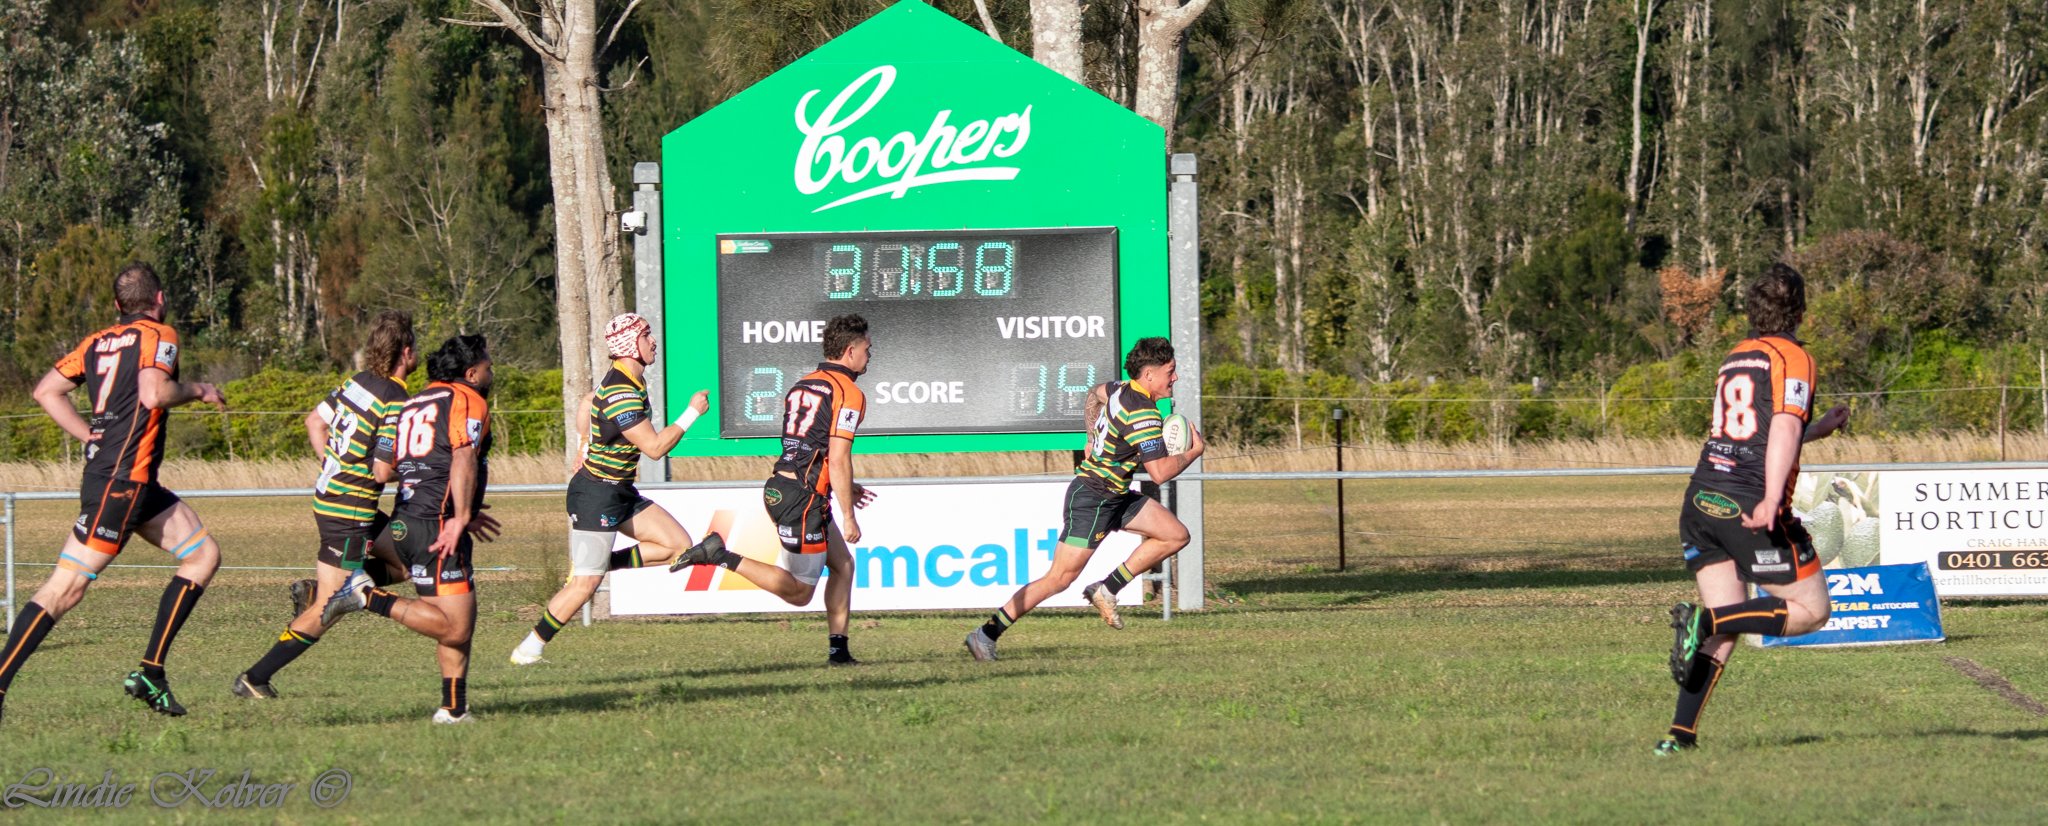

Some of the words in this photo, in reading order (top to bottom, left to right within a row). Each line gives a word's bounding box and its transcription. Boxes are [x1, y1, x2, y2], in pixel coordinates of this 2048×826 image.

[794, 64, 1033, 200] Coopers
[743, 320, 827, 344] HOME
[996, 315, 1106, 340] VISITOR
[95, 350, 121, 414] 7
[875, 381, 965, 404] SCORE
[786, 389, 823, 437] 17
[396, 402, 438, 461] 16
[1914, 481, 2048, 502] SUMMER
[1895, 509, 2045, 531] HORTICU
[1966, 538, 2013, 549] CRAIG
[853, 527, 1060, 589] mcal+
[1947, 553, 2003, 569] 0401
[2011, 552, 2048, 568] 663
[1871, 601, 1920, 610] AUTOCARE
[1819, 614, 1892, 632] EMPSEY
